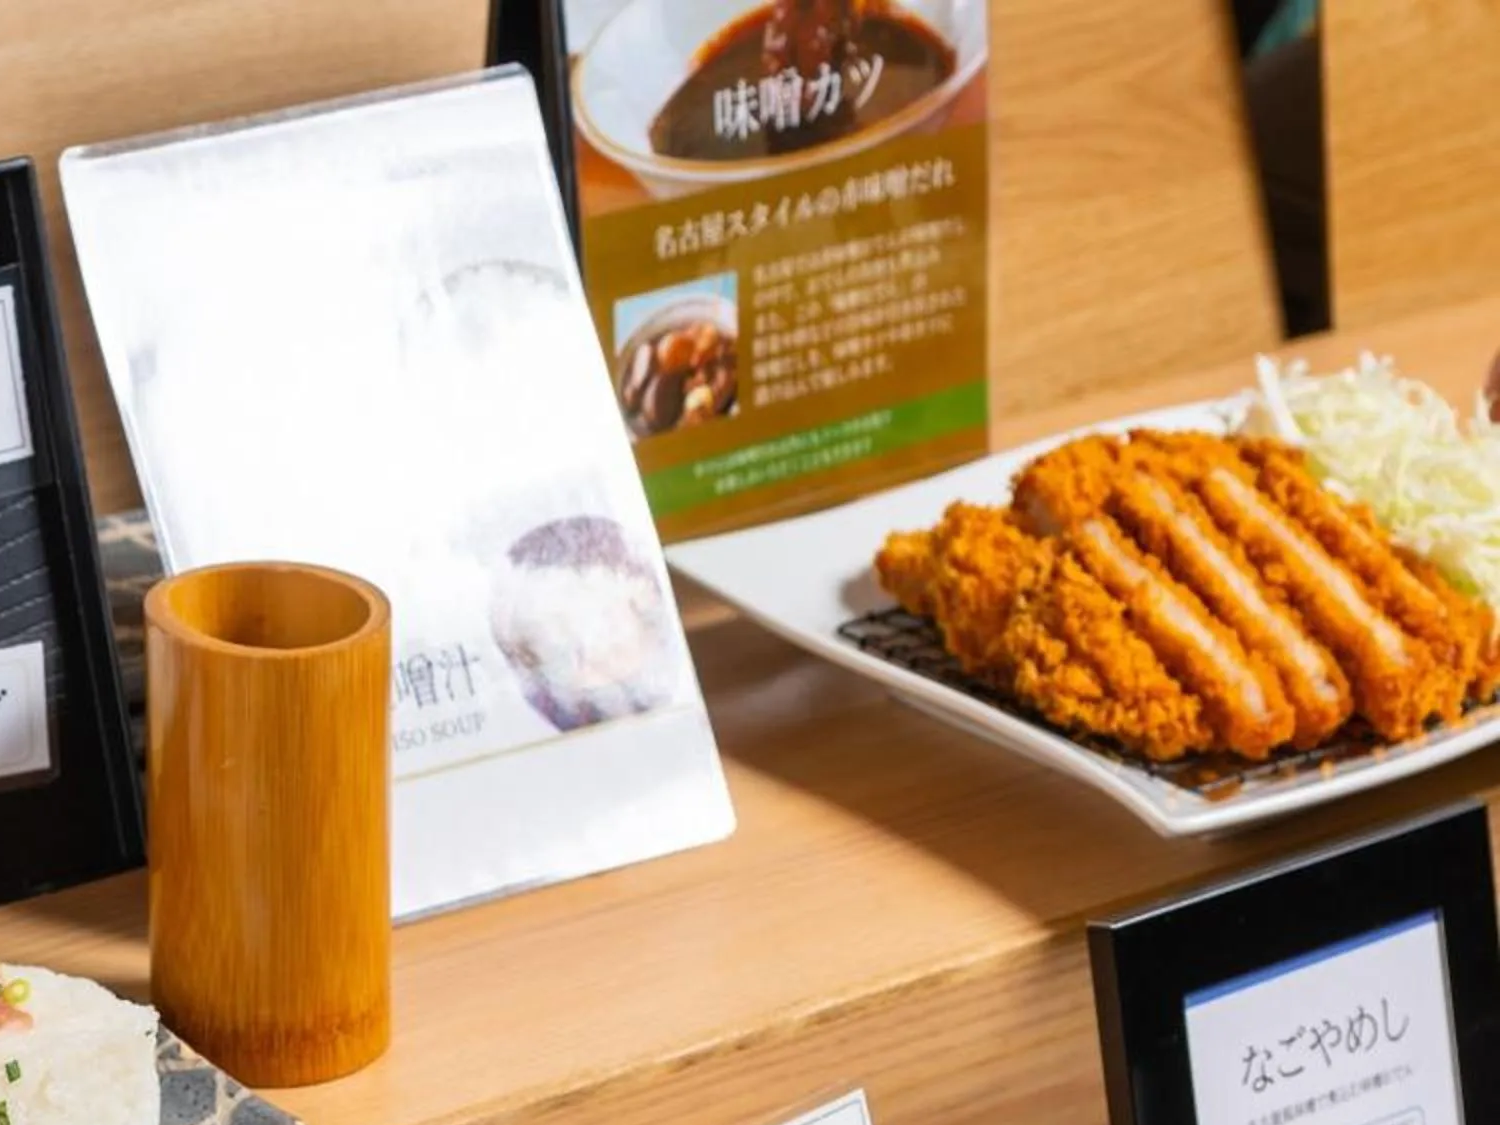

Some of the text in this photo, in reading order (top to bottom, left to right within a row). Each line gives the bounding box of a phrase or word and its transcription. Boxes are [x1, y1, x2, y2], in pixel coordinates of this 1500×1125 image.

[713, 53, 884, 140] 味噌カツ
[430, 711, 485, 742] SOUP
[1242, 996, 1409, 1094] なごやめし
